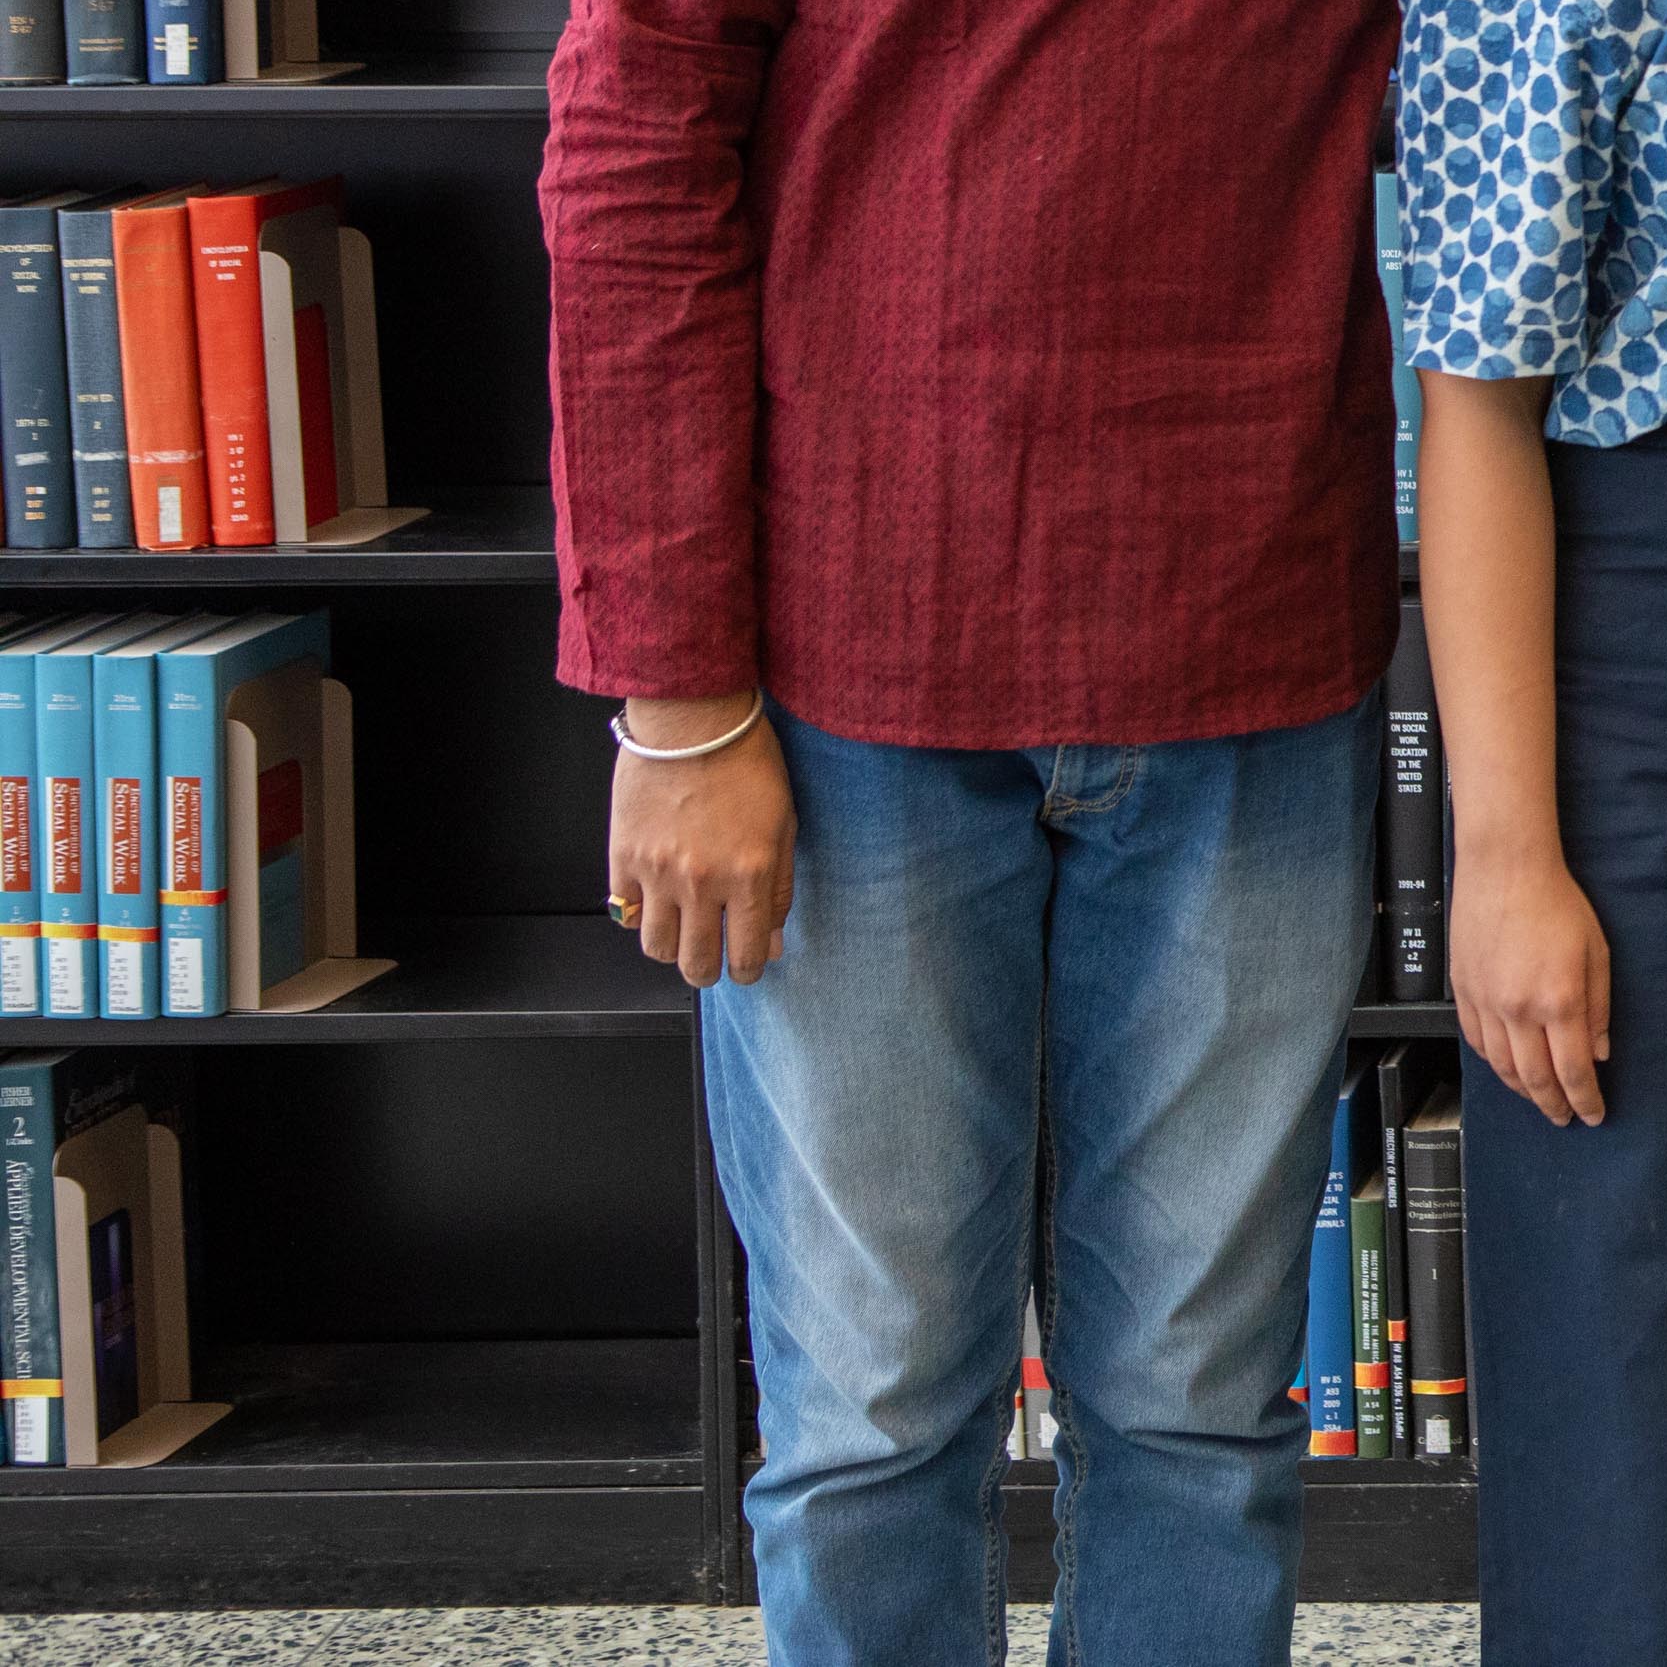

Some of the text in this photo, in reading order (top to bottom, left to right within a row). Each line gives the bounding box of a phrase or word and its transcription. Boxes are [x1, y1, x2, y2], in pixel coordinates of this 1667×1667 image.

[1397, 432, 1412, 442] 2001
[1389, 712, 1428, 720] STATISTICS
[1391, 724, 1427, 733] ON SOCIAL
[1399, 736, 1418, 745] WORK
[1391, 748, 1428, 757] EDUCATION
[70, 787, 80, 858] ENCYCLOPEDIA
[54, 782, 70, 884] SOCIAL WORK
[175, 782, 190, 884] SOCIAL WORK
[1398, 880, 1424, 890] 1991-94
[12, 1116, 26, 1138] 2
[1408, 1141, 1458, 1150] Romanofsky
[1385, 1127, 1397, 1208] DIRECTORY OF MEMBERS
[1409, 1200, 1460, 1209] Social Service
[5, 1160, 31, 1348] APPLIED DEVELOPMENTAL
[1432, 1268, 1438, 1280] 1
